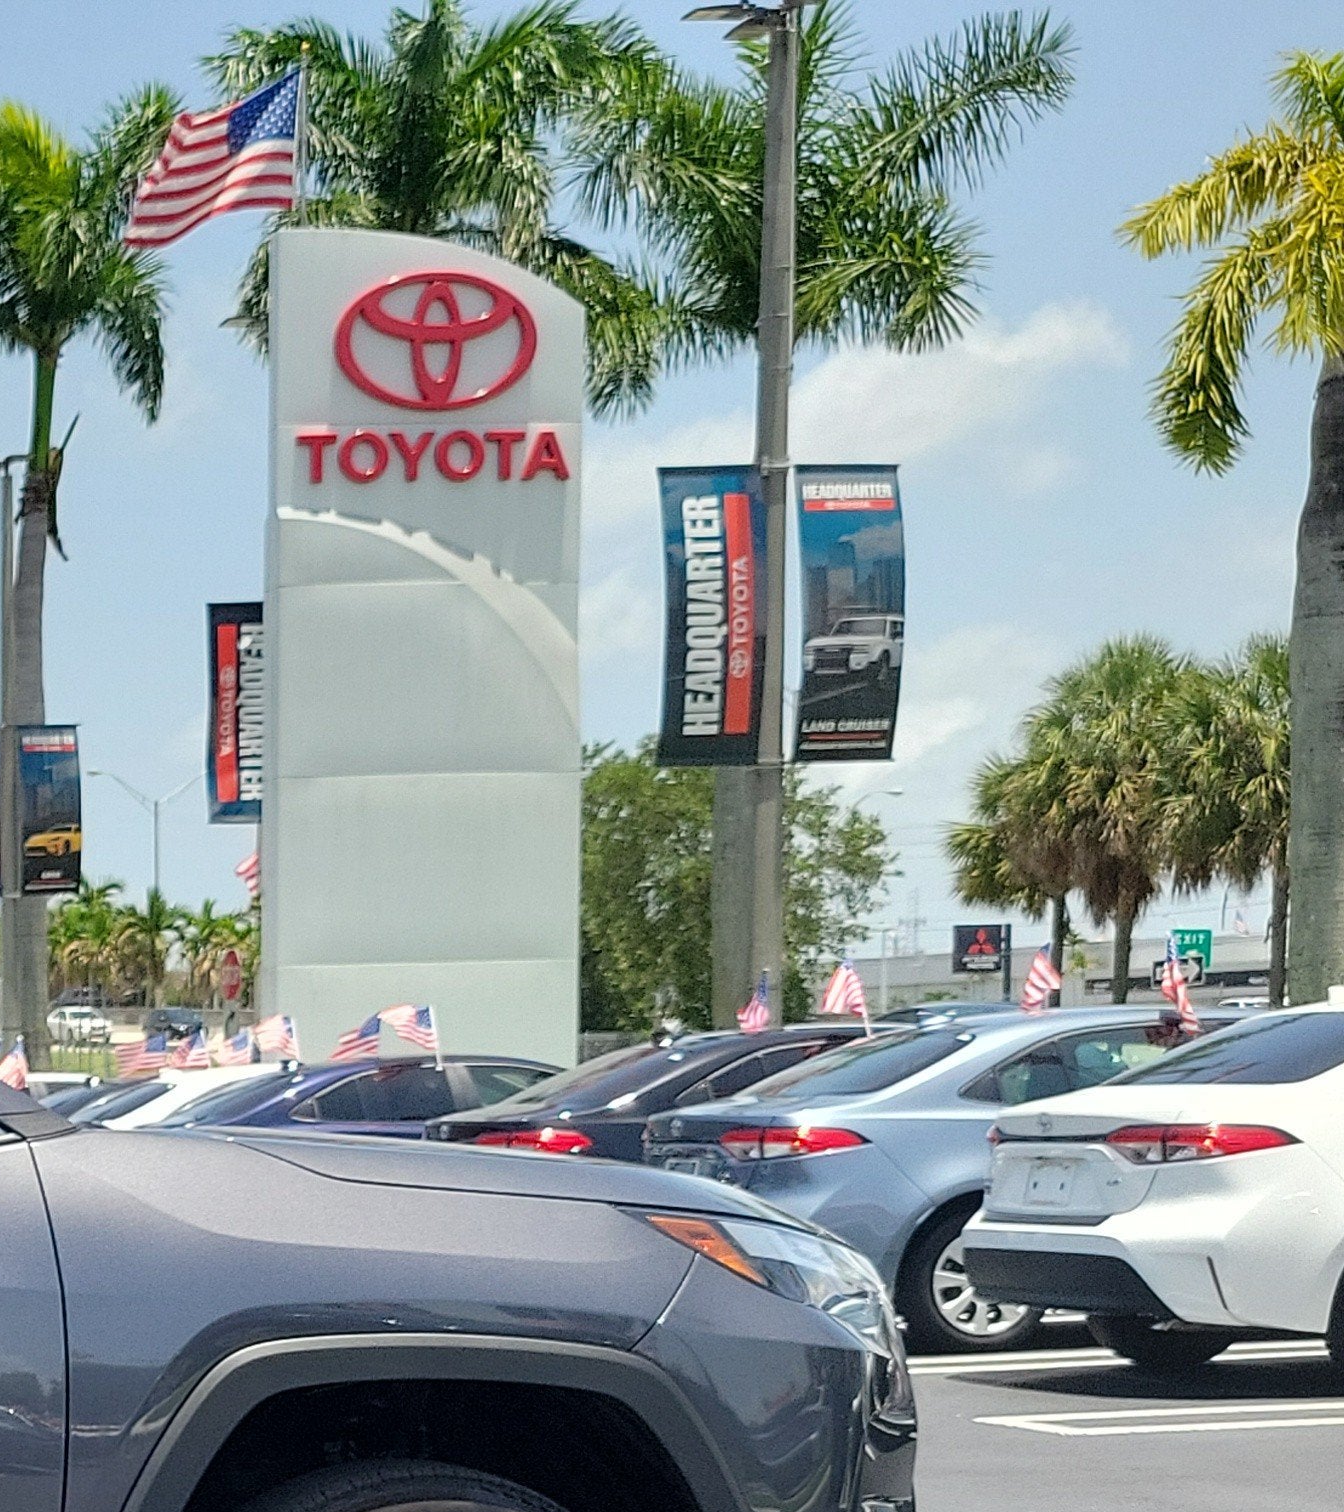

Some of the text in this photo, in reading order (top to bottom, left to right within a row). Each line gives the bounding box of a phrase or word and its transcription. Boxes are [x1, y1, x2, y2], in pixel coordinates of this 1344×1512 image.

[295, 428, 570, 484] TOYOTA
[803, 484, 891, 500] HEADQUARTER
[682, 494, 727, 736] HEADQUARTER
[732, 555, 750, 648] TOYOTA
[220, 688, 235, 757] TOYOTA
